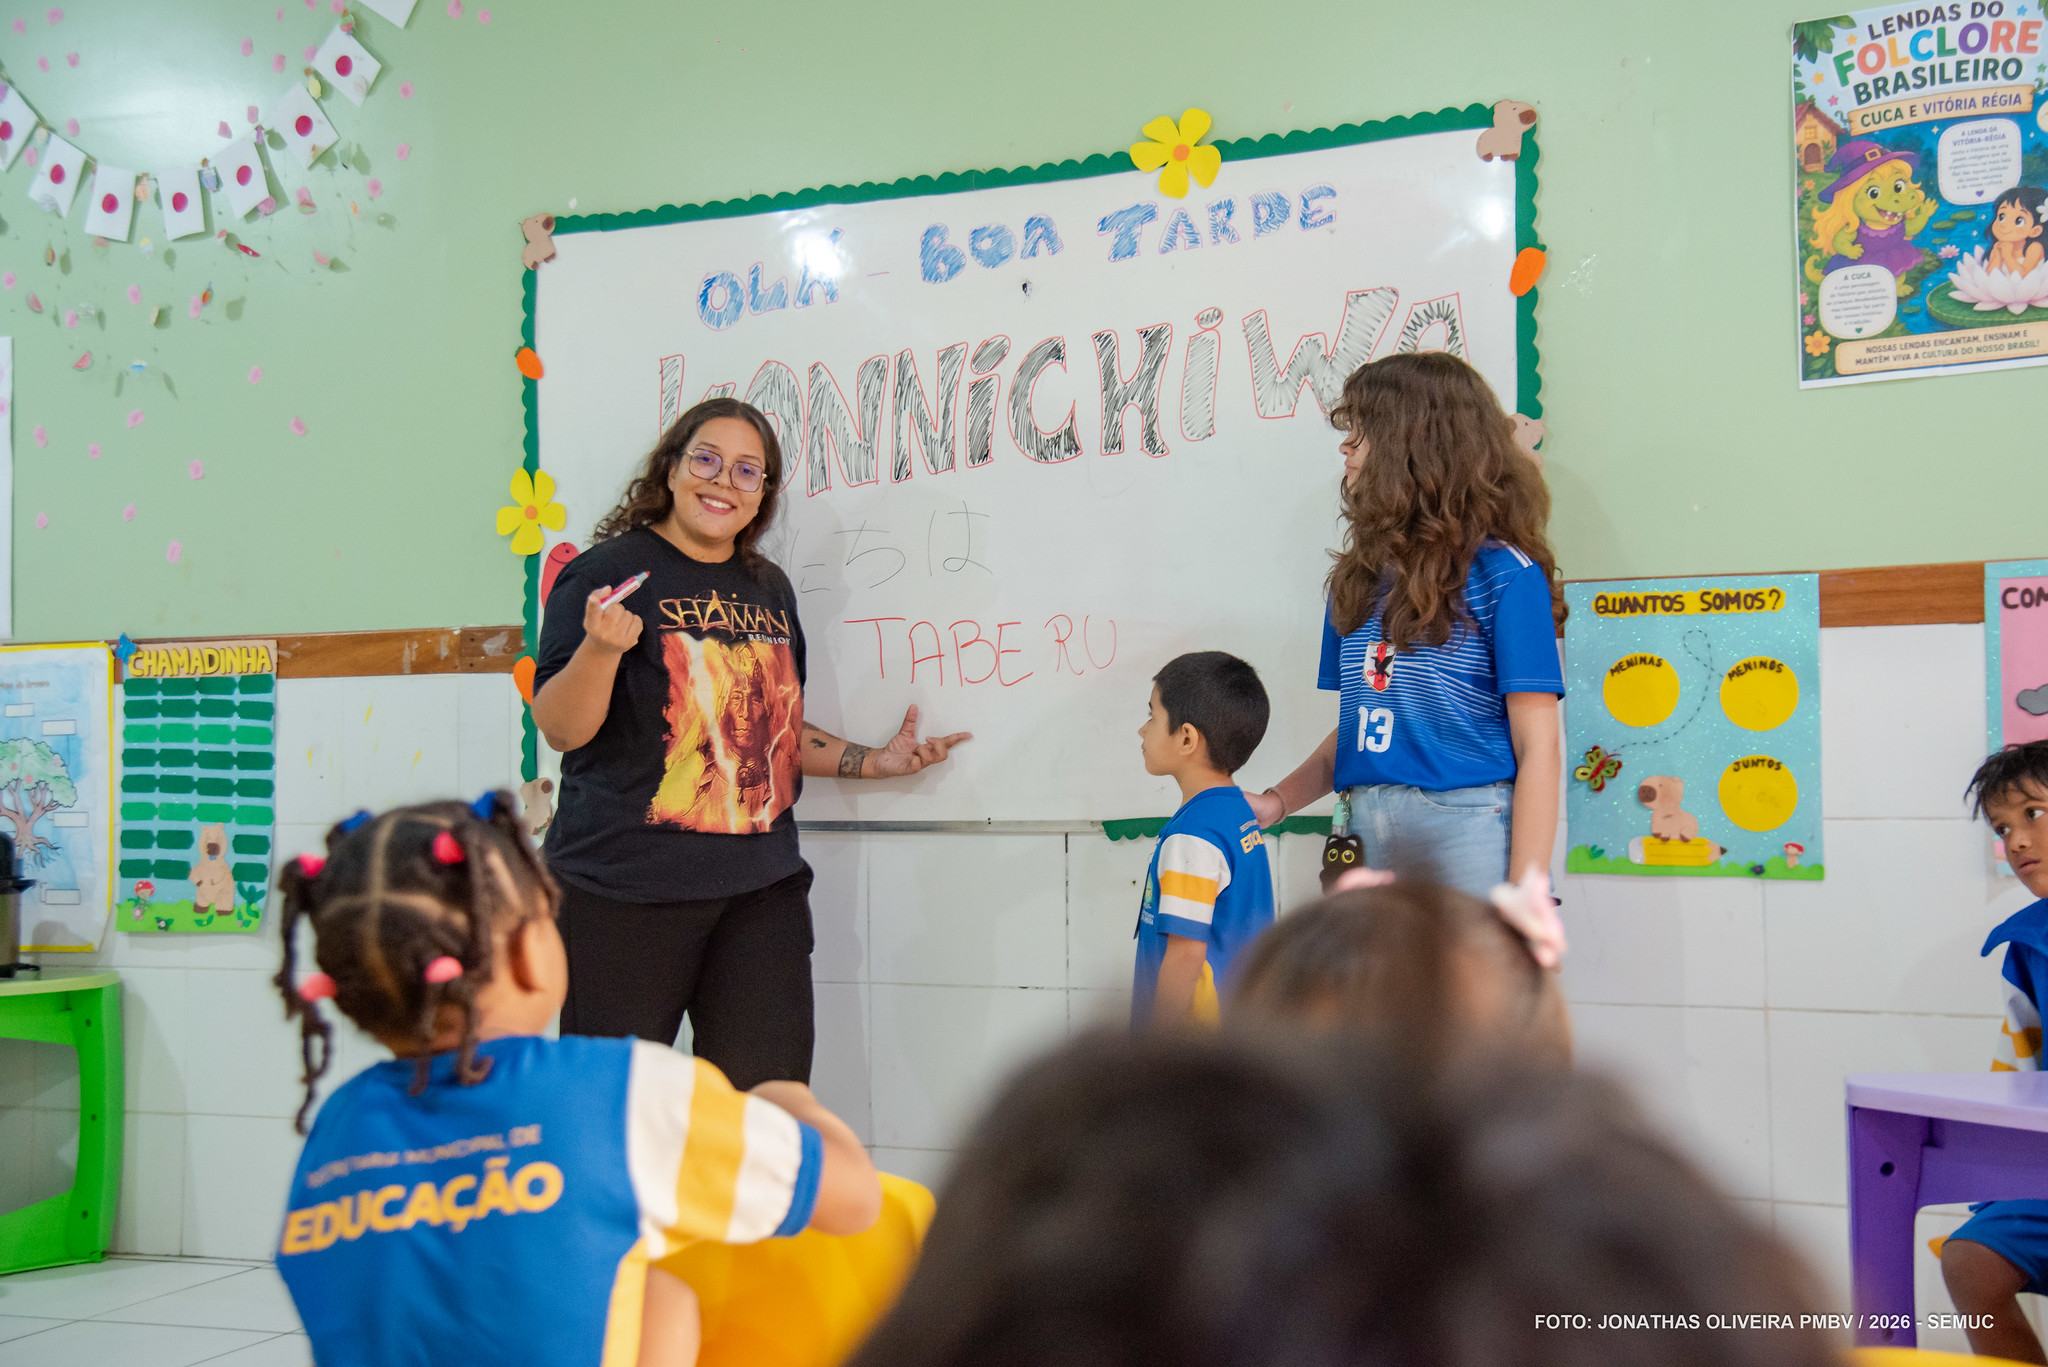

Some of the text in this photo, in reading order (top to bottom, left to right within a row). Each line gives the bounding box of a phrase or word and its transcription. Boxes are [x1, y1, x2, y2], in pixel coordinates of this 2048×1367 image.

[1867, 1, 2004, 40] LENDAS DO
[1833, 20, 2043, 87] FOLCLORE
[1853, 57, 2023, 105] BRASILEIRO
[1860, 92, 2022, 127] CUCA E VITÓRIA RÉGIA
[697, 227, 845, 331] OLÁ
[919, 213, 1064, 284] BOA
[1097, 182, 1338, 262] TARDE
[1855, 340, 2040, 365] MANTÉM VIVA A CULTURA DO NOSSO BRASIL!
[1866, 344, 1897, 354] NOSSAS
[1899, 340, 1931, 351] LENDAS
[1984, 331, 2021, 342] ENSINAM
[2023, 330, 2028, 338] E
[658, 590, 790, 638] SHAMAN
[1594, 588, 1782, 615] QUANTOS SOMOS?
[128, 646, 273, 676] CHAMADINHA
[1610, 655, 1663, 677] MENINAS
[1728, 660, 1784, 681] MENINOS
[1357, 706, 1394, 753] 13
[1733, 756, 1783, 773] JUNTOS
[279, 1155, 565, 1256] EDUCAÇÃO
